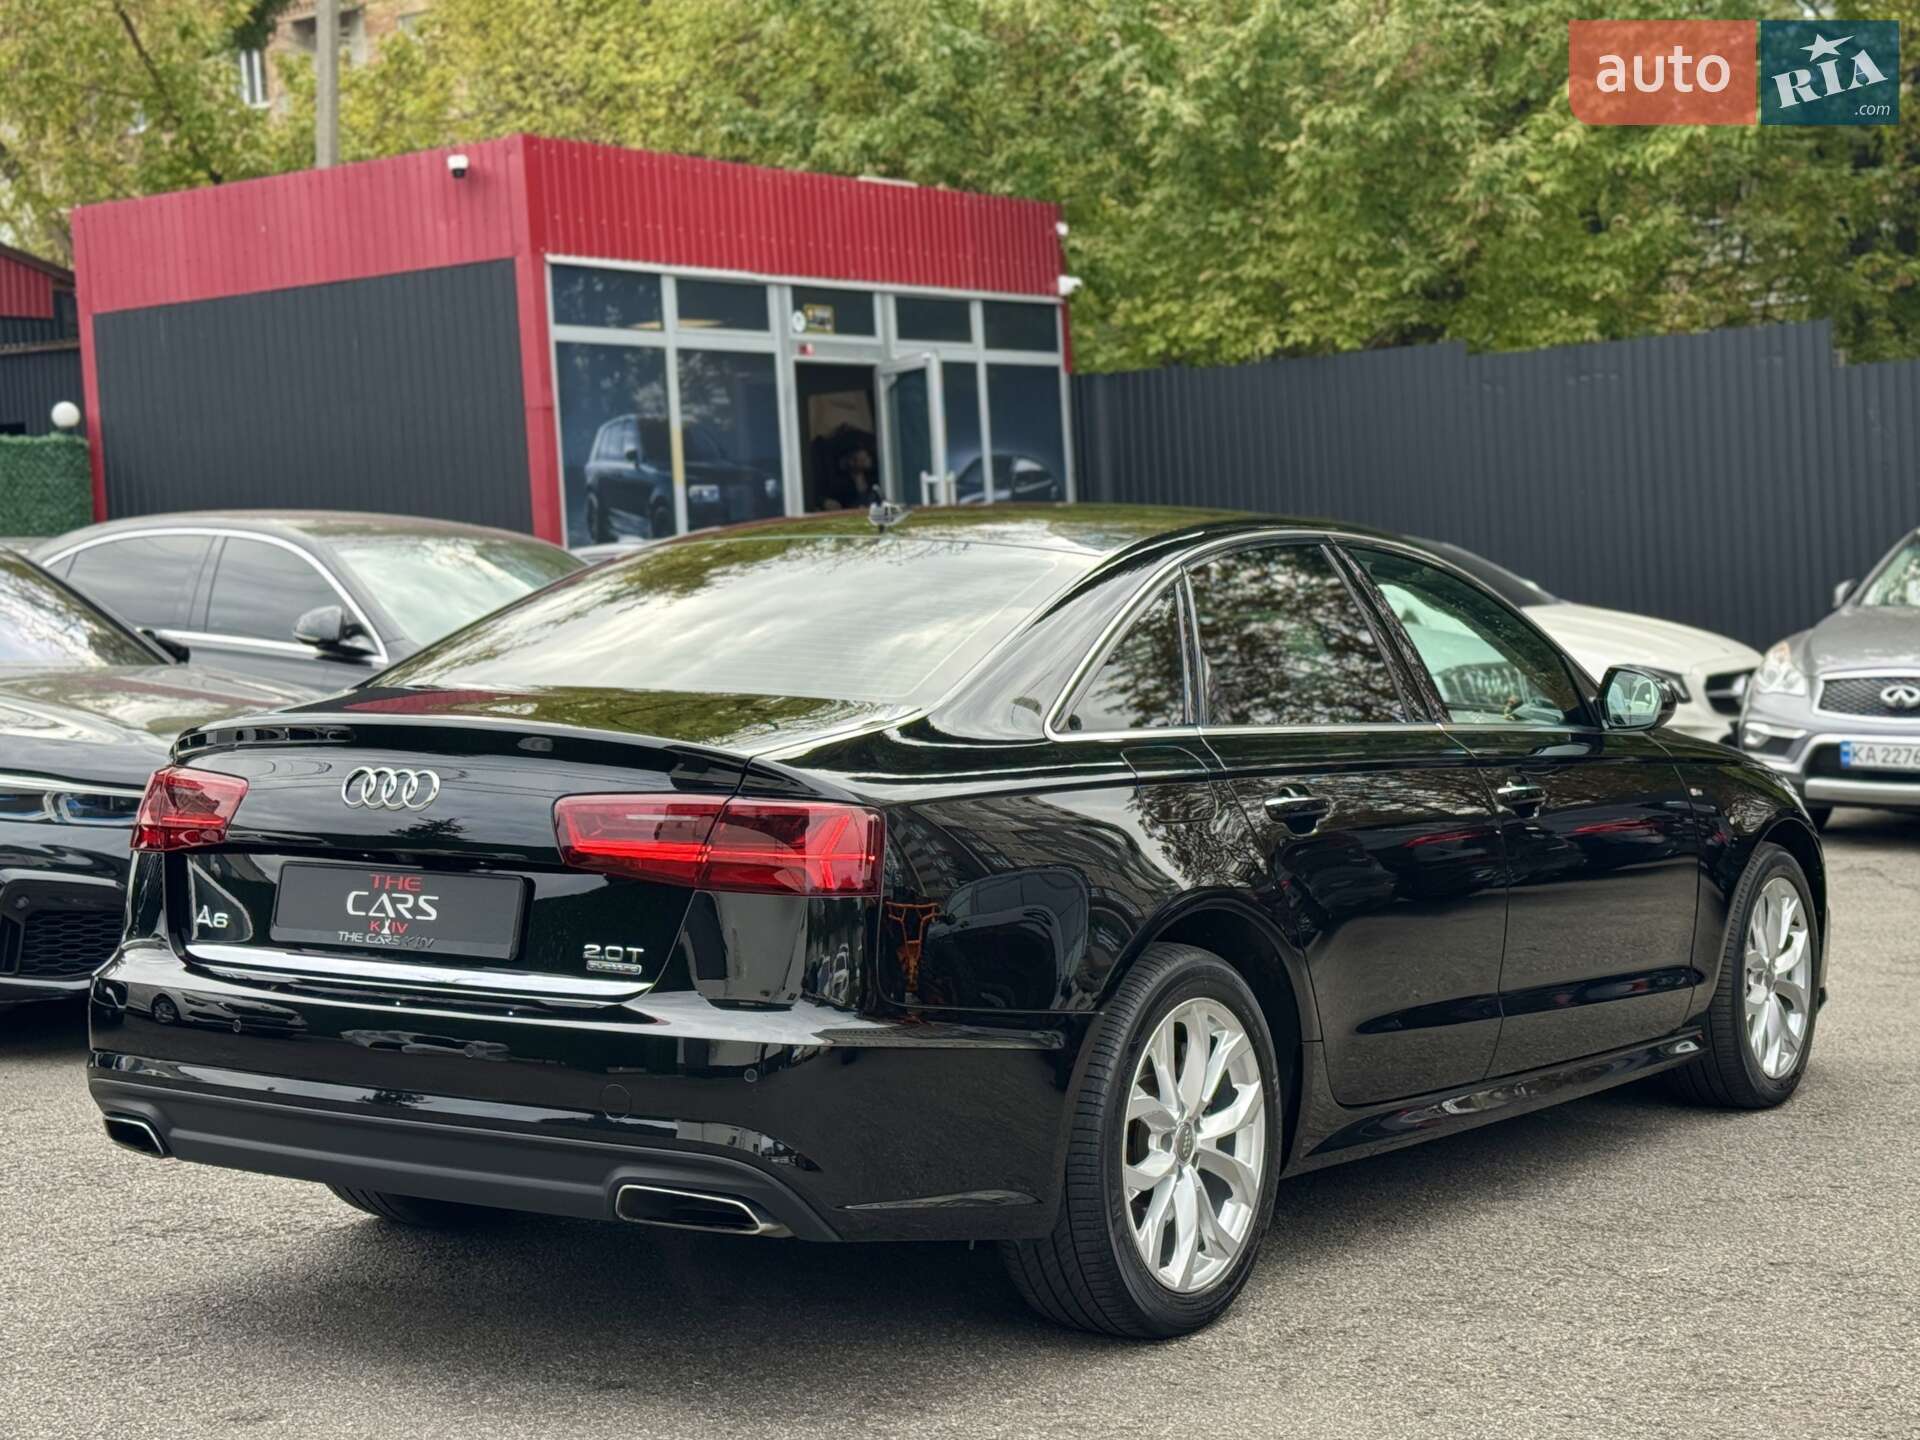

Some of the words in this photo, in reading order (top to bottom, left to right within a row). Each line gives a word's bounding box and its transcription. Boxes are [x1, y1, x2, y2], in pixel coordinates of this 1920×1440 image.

[369, 873, 423, 891] THE
[346, 890, 439, 921] CARS
[196, 904, 229, 928] A6
[338, 931, 364, 943] THE
[366, 933, 401, 946] CARS
[583, 944, 644, 963] 2.0T
